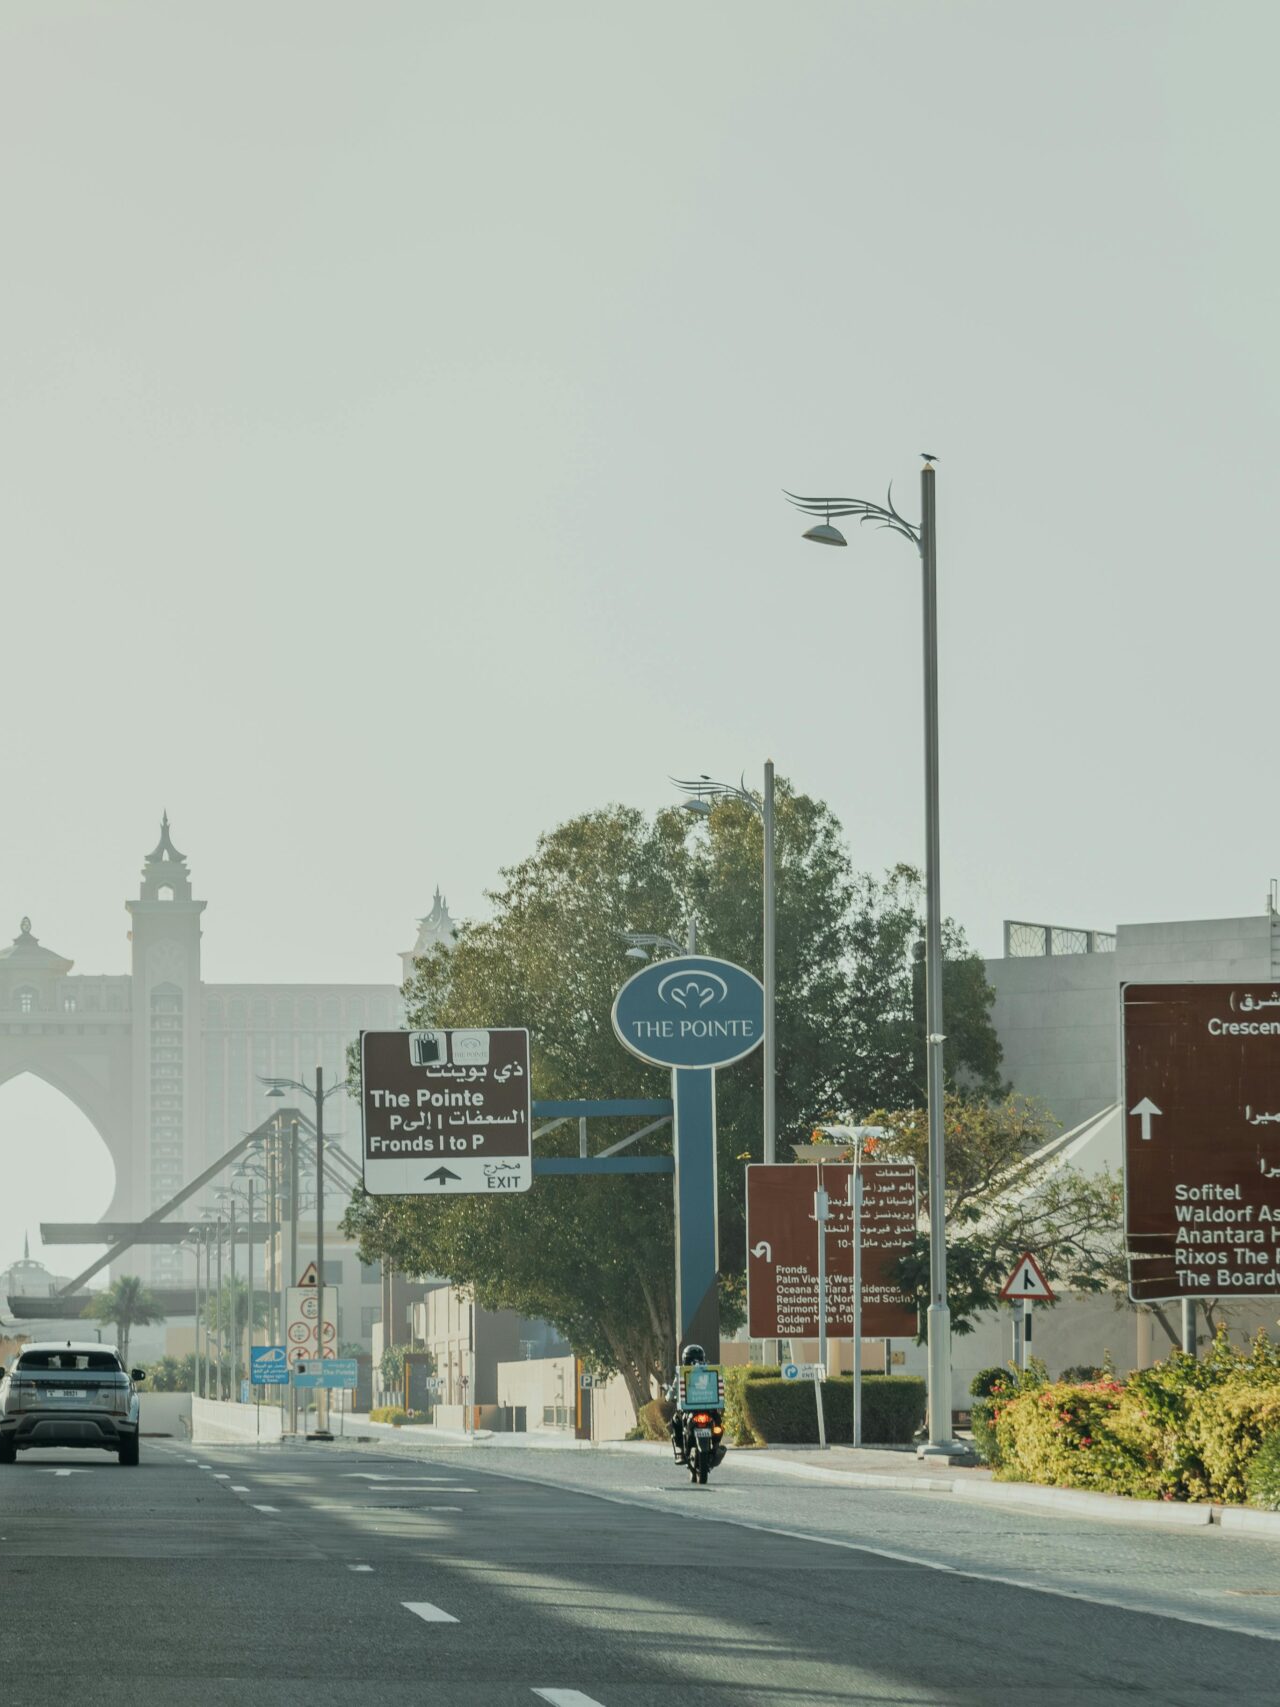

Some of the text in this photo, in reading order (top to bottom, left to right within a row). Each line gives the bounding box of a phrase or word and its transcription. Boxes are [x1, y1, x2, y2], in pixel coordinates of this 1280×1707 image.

[632, 1020, 754, 1038] THE POINTE
[426, 1061, 524, 1083] ذي بوينت
[370, 1089, 484, 1108] The Pointe
[449, 1109, 525, 1126] السعفات
[370, 1136, 434, 1152] Fronds
[449, 1136, 467, 1150] to
[472, 1134, 485, 1150] P
[483, 1160, 521, 1177] مخرج
[487, 1176, 521, 1189] EXIT
[1175, 1184, 1242, 1200] Sofitel
[1175, 1205, 1253, 1222] Waldorf
[1175, 1226, 1265, 1244] Anantara
[1175, 1248, 1228, 1265] Rixos
[1233, 1248, 1269, 1265] The
[776, 1265, 808, 1274] Fronds
[776, 1275, 800, 1284] Palm
[1175, 1270, 1211, 1287] The
[776, 1285, 812, 1294] Oceana
[849, 1285, 901, 1294] Rsidences
[863, 1295, 880, 1303] and
[776, 1304, 818, 1313] Fairmont
[824, 1304, 837, 1313] he
[777, 1315, 854, 1324] Golden Mle 1-10
[777, 1325, 804, 1334] Dubai
